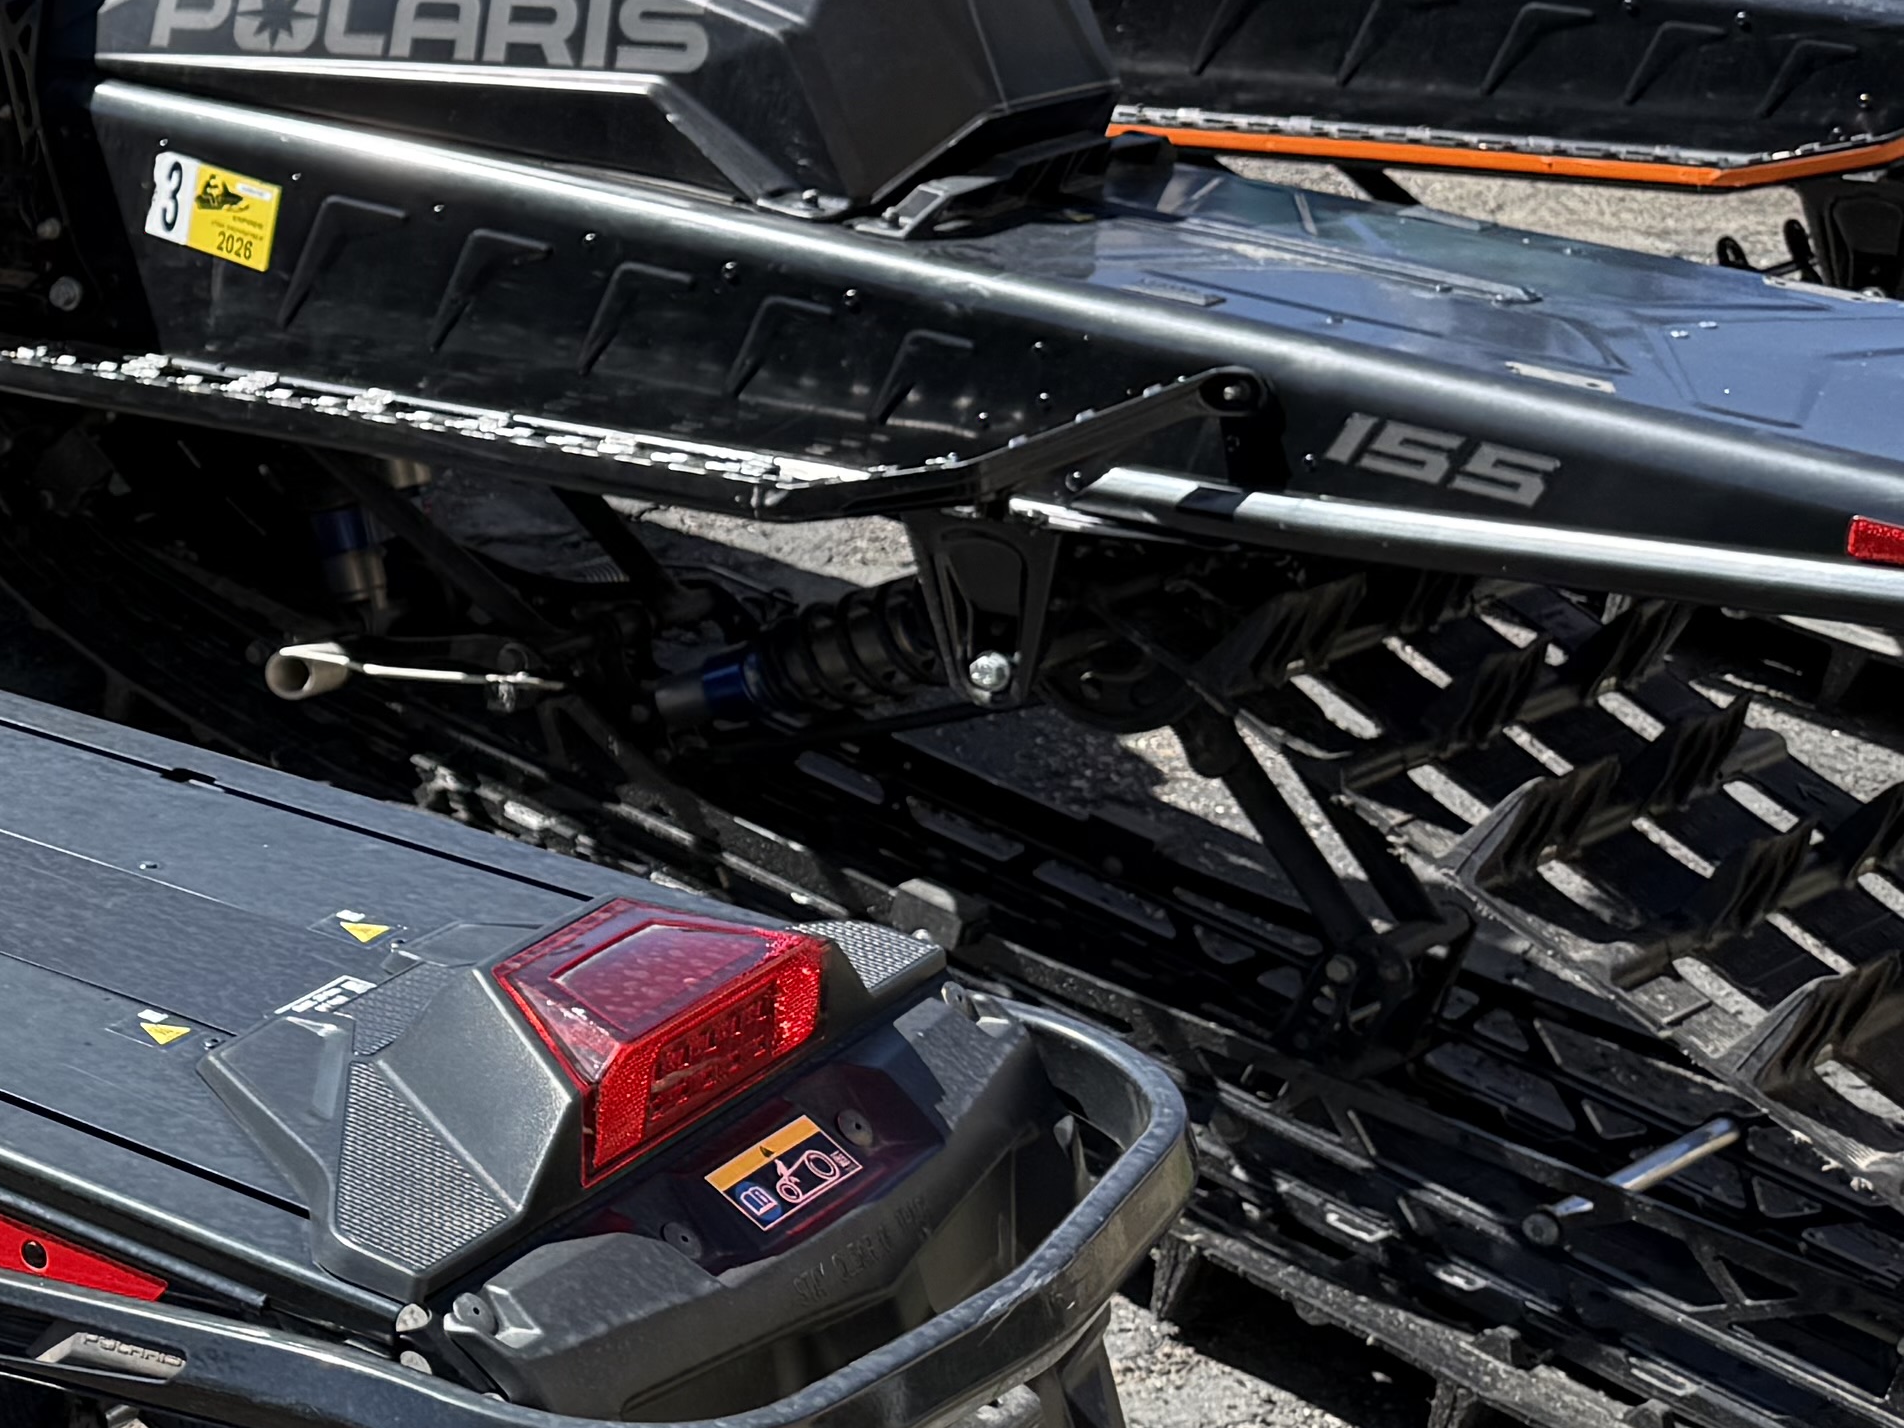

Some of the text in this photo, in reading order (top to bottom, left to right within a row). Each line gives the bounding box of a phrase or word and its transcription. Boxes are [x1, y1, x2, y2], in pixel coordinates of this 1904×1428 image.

[161, 160, 184, 233] 3
[216, 230, 254, 262] 2026
[1323, 411, 1561, 508] 155
[82, 1331, 184, 1368] POLARIS
